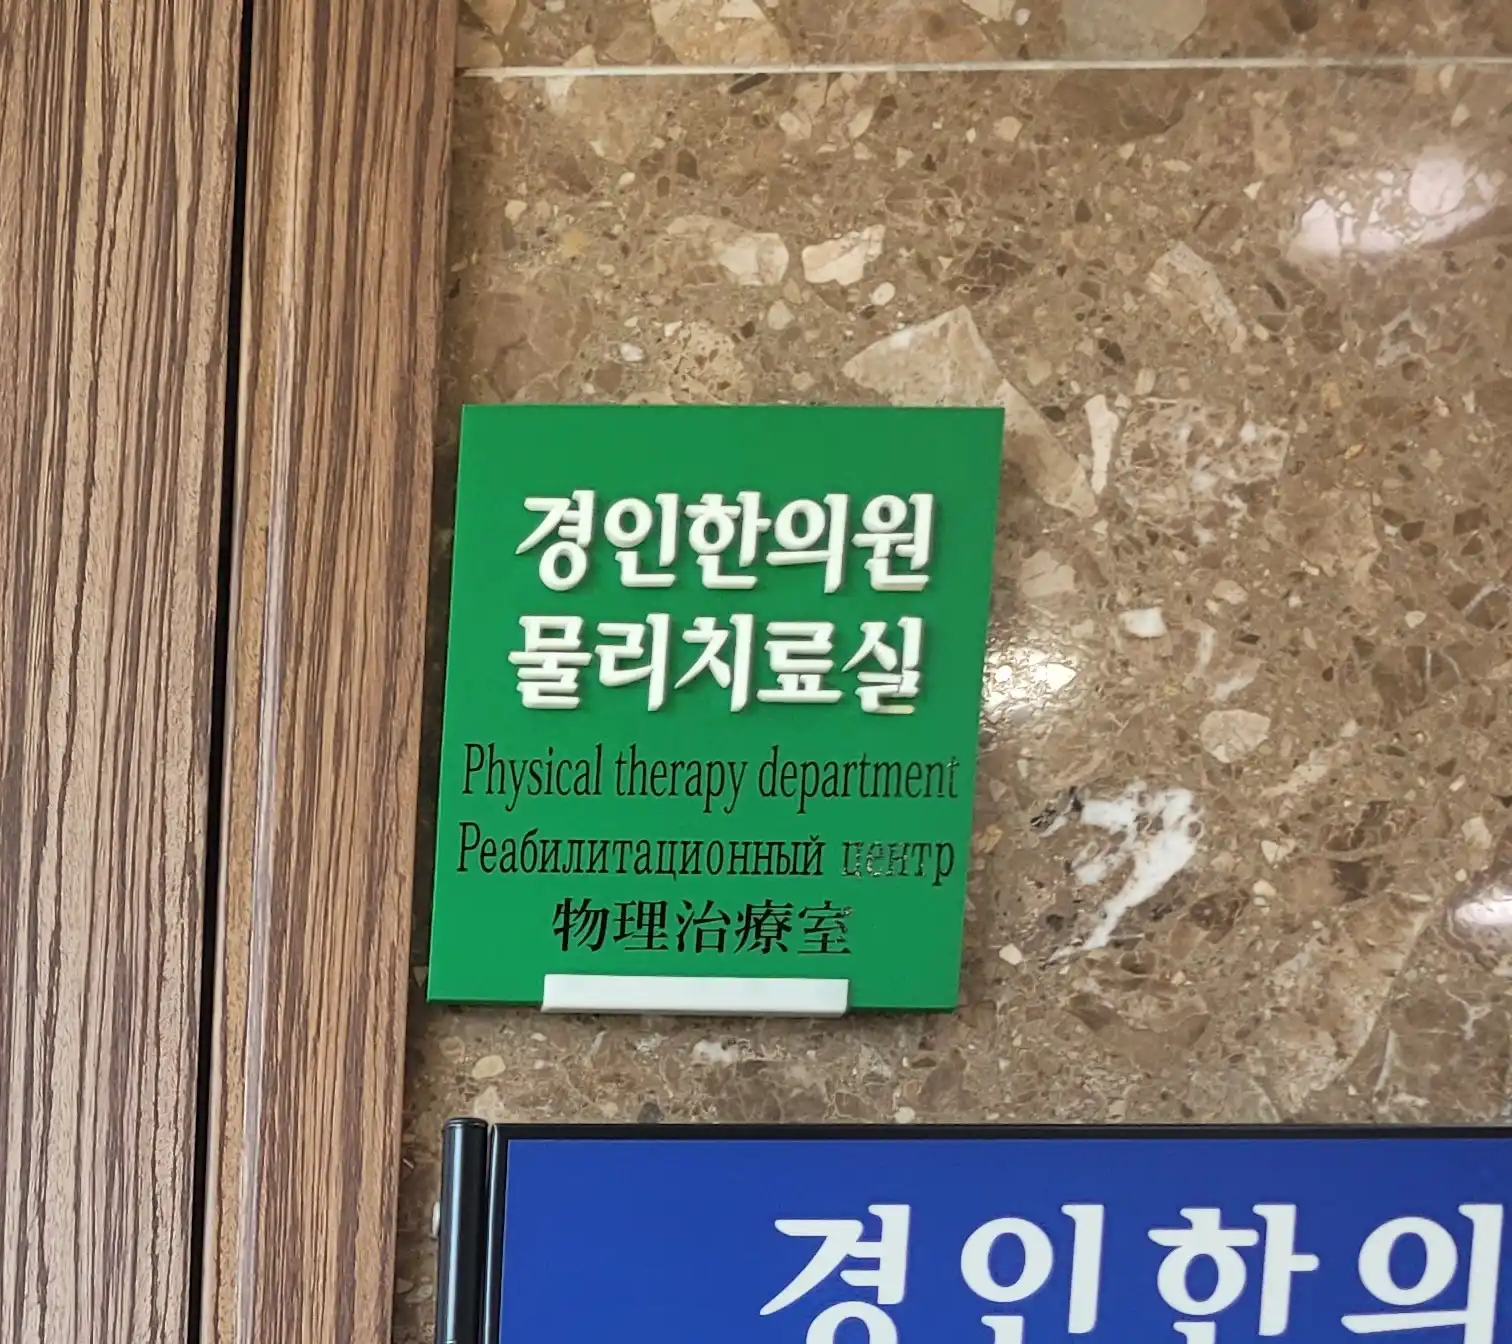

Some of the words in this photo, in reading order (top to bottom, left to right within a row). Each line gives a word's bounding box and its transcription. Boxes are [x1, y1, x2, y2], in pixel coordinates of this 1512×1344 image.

[515, 490, 934, 593] 경인한의원
[507, 613, 924, 714] 물리치료실
[462, 743, 603, 812] Physical
[615, 747, 747, 814] therapy
[757, 745, 960, 814] department
[457, 821, 824, 882] Реабилитационный
[841, 838, 955, 886] центр
[552, 896, 853, 956] 物理治療室
